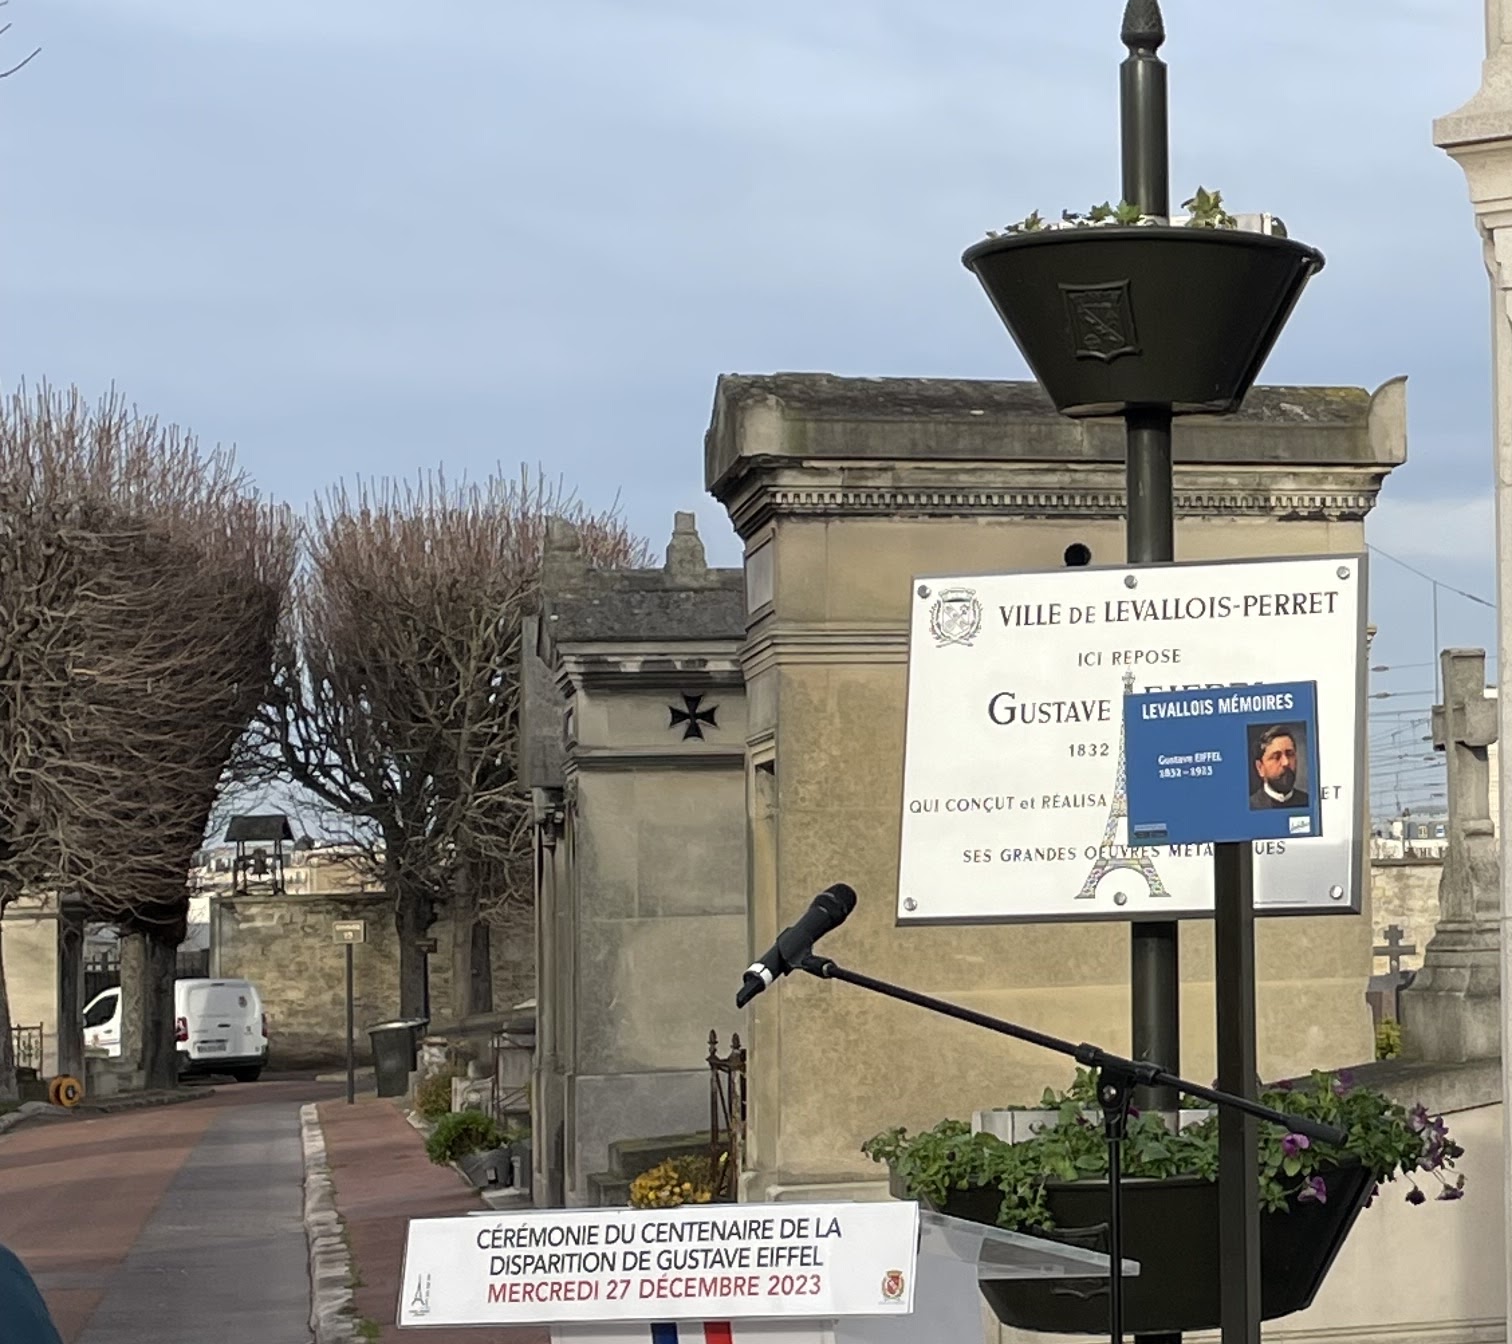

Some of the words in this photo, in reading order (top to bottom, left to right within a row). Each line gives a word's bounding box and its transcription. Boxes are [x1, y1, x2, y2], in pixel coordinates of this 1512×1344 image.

[998, 602, 1062, 628] VILLE
[1069, 605, 1096, 625] DE
[1104, 591, 1339, 623] LEVALLOIS-PERRET
[1077, 651, 1103, 667] ICI
[1111, 648, 1182, 666] REPOSE
[1141, 698, 1214, 720] LEVALLOIS
[1217, 692, 1295, 715] MÉMOIRES
[1068, 742, 1110, 758] 1832
[909, 799, 940, 814] QUI
[945, 796, 1015, 814] CONÇUT
[1019, 798, 1036, 810] et
[1041, 793, 1107, 810] RÉALISA
[963, 849, 992, 864] SES
[1000, 847, 1077, 863] GRANDES
[476, 1222, 600, 1250] CÉRÉMONIE
[604, 1223, 637, 1246] DU
[641, 1218, 775, 1244] CENTENAIRE
[779, 1217, 811, 1240] DE
[815, 1216, 843, 1239] LA
[489, 1251, 617, 1276] DISPARITION
[621, 1250, 652, 1272] DE
[656, 1246, 751, 1271] GUSTAVE
[756, 1245, 825, 1268] EIFFEL
[487, 1280, 600, 1304] MERCREDI
[605, 1278, 632, 1301] 27
[638, 1272, 761, 1300] DÉCEMBRE
[766, 1273, 823, 1297] 2023
